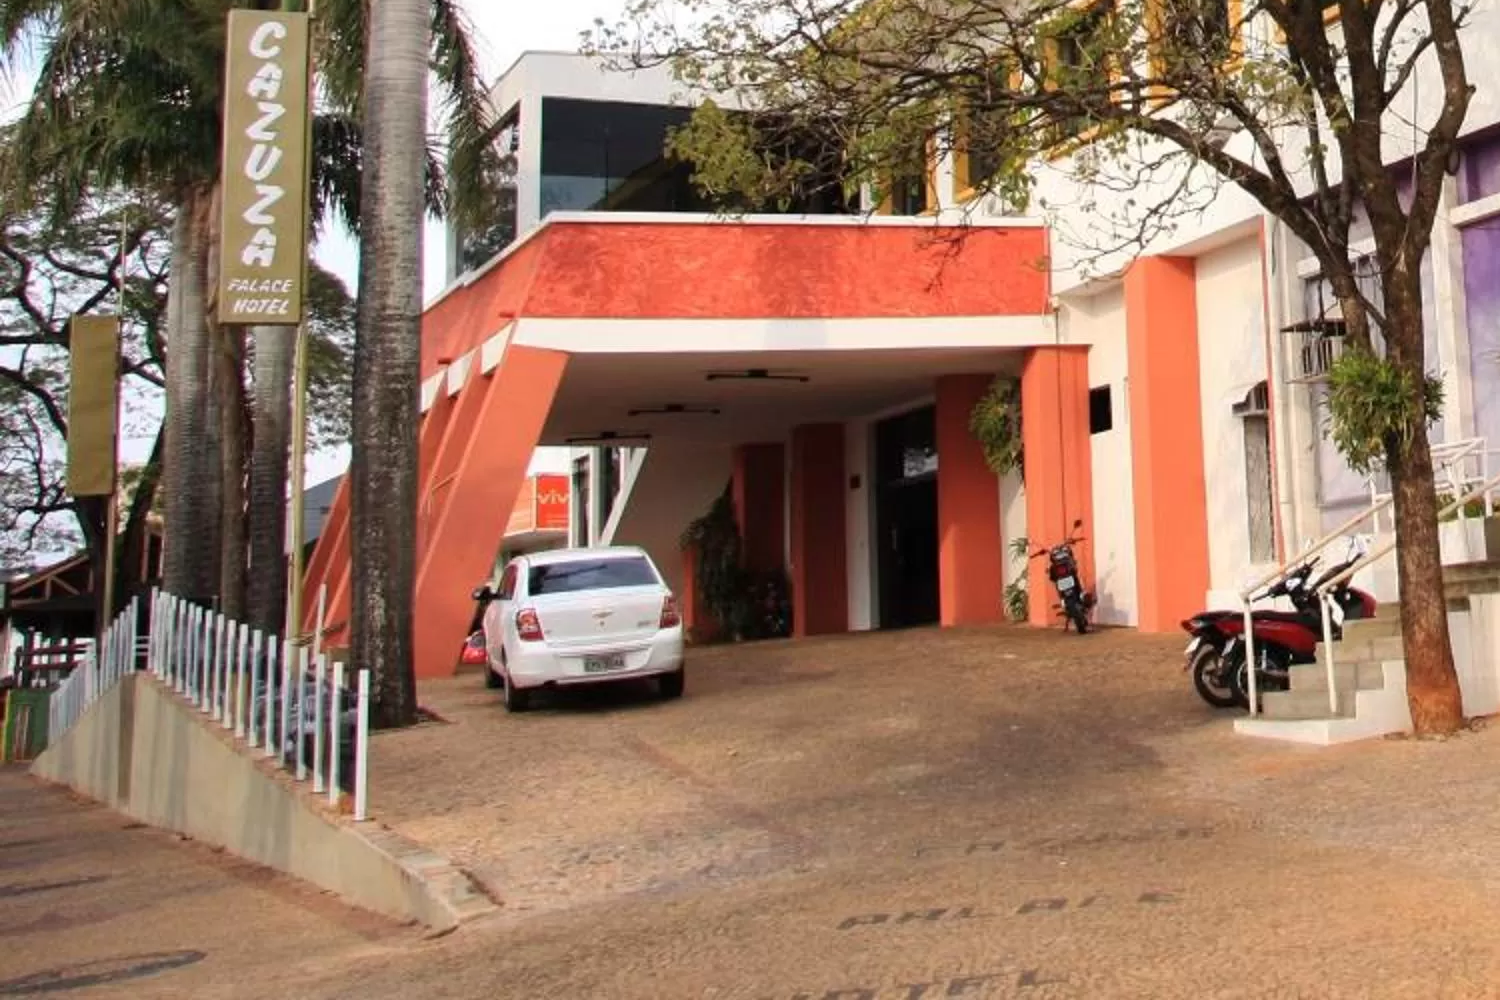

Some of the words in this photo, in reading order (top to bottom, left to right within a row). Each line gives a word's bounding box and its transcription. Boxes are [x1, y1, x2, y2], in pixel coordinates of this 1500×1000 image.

[242, 21, 287, 268] CAZUZA
[227, 279, 294, 293] PALACE
[233, 298, 290, 316] HOTEL
[538, 487, 569, 505] viv
